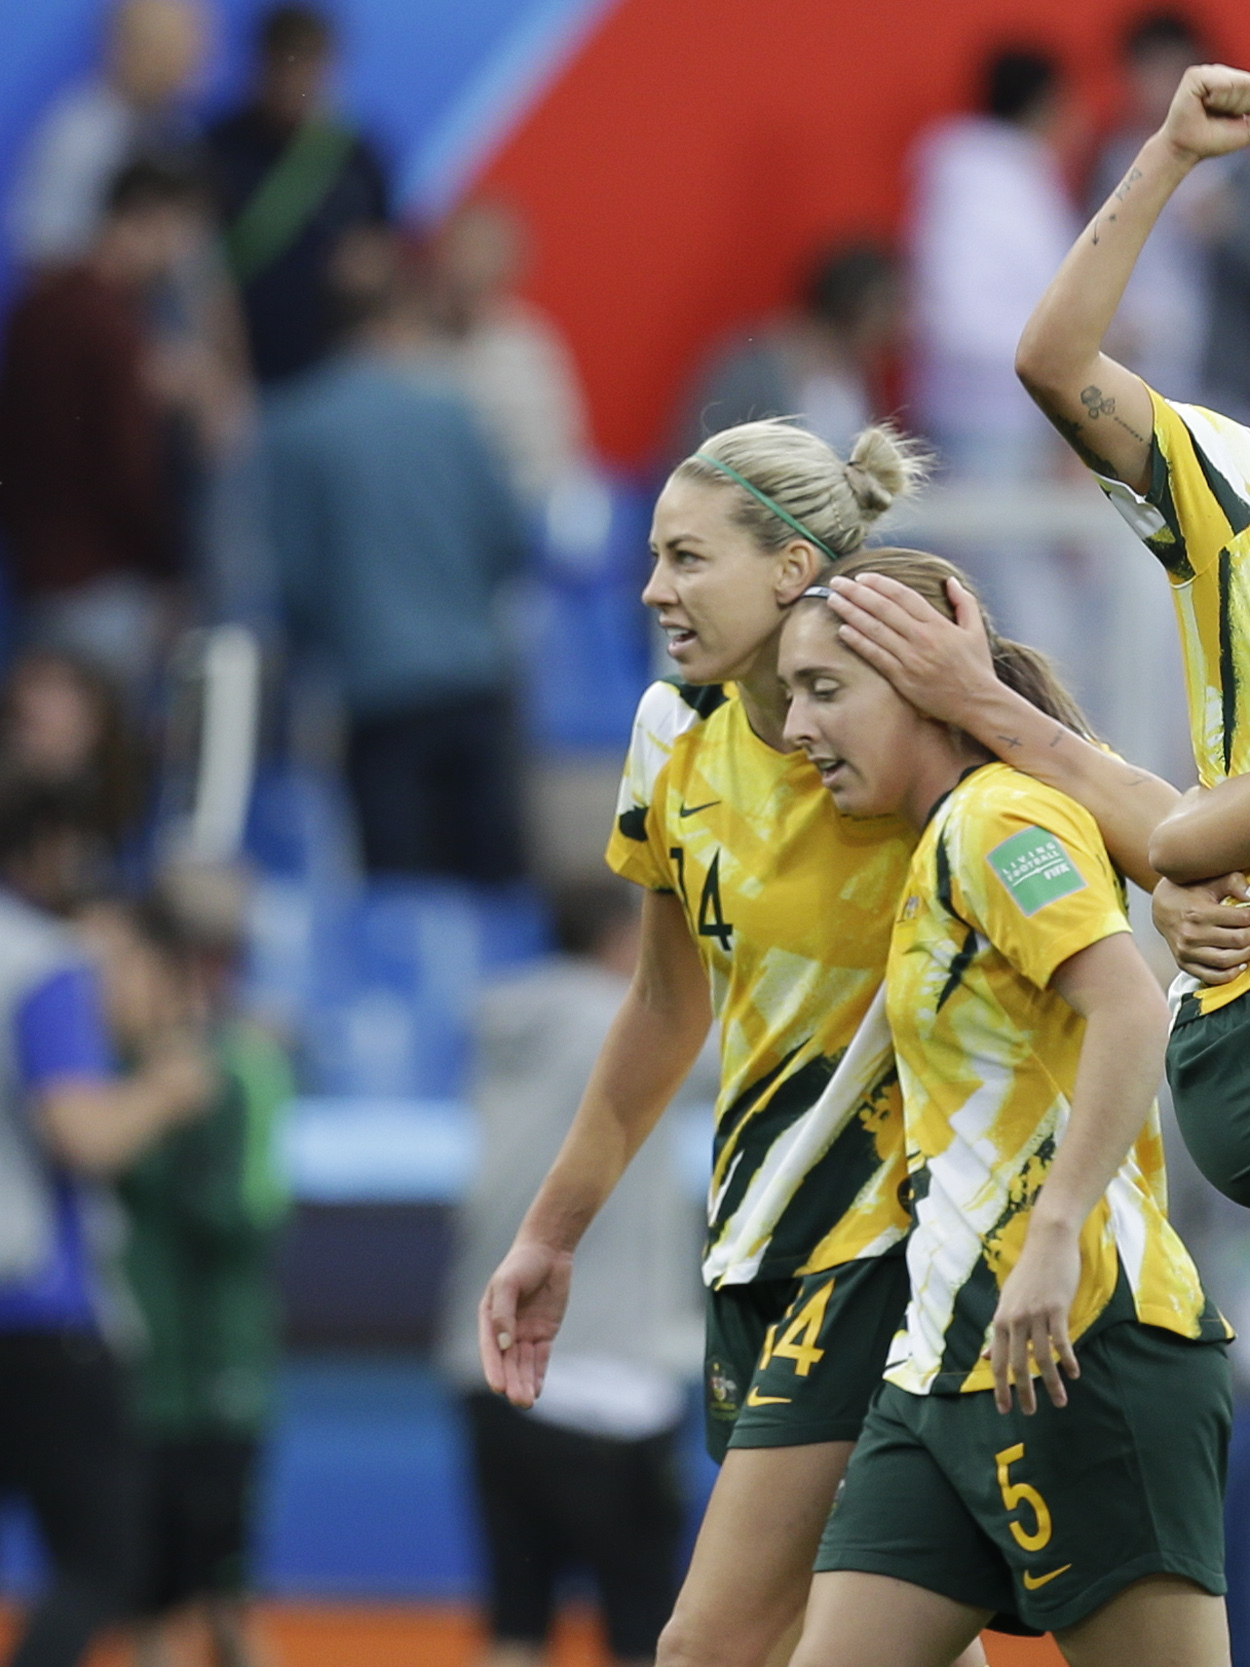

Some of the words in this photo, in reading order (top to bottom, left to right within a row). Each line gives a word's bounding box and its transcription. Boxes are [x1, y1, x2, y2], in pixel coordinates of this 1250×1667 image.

[1002, 841, 1056, 874] LIVING
[1007, 850, 1061, 881] FOOTBALL
[1043, 862, 1070, 881] FIFA
[669, 847, 733, 952] 14
[759, 1277, 836, 1377] 14
[995, 1442, 1053, 1552] 5
